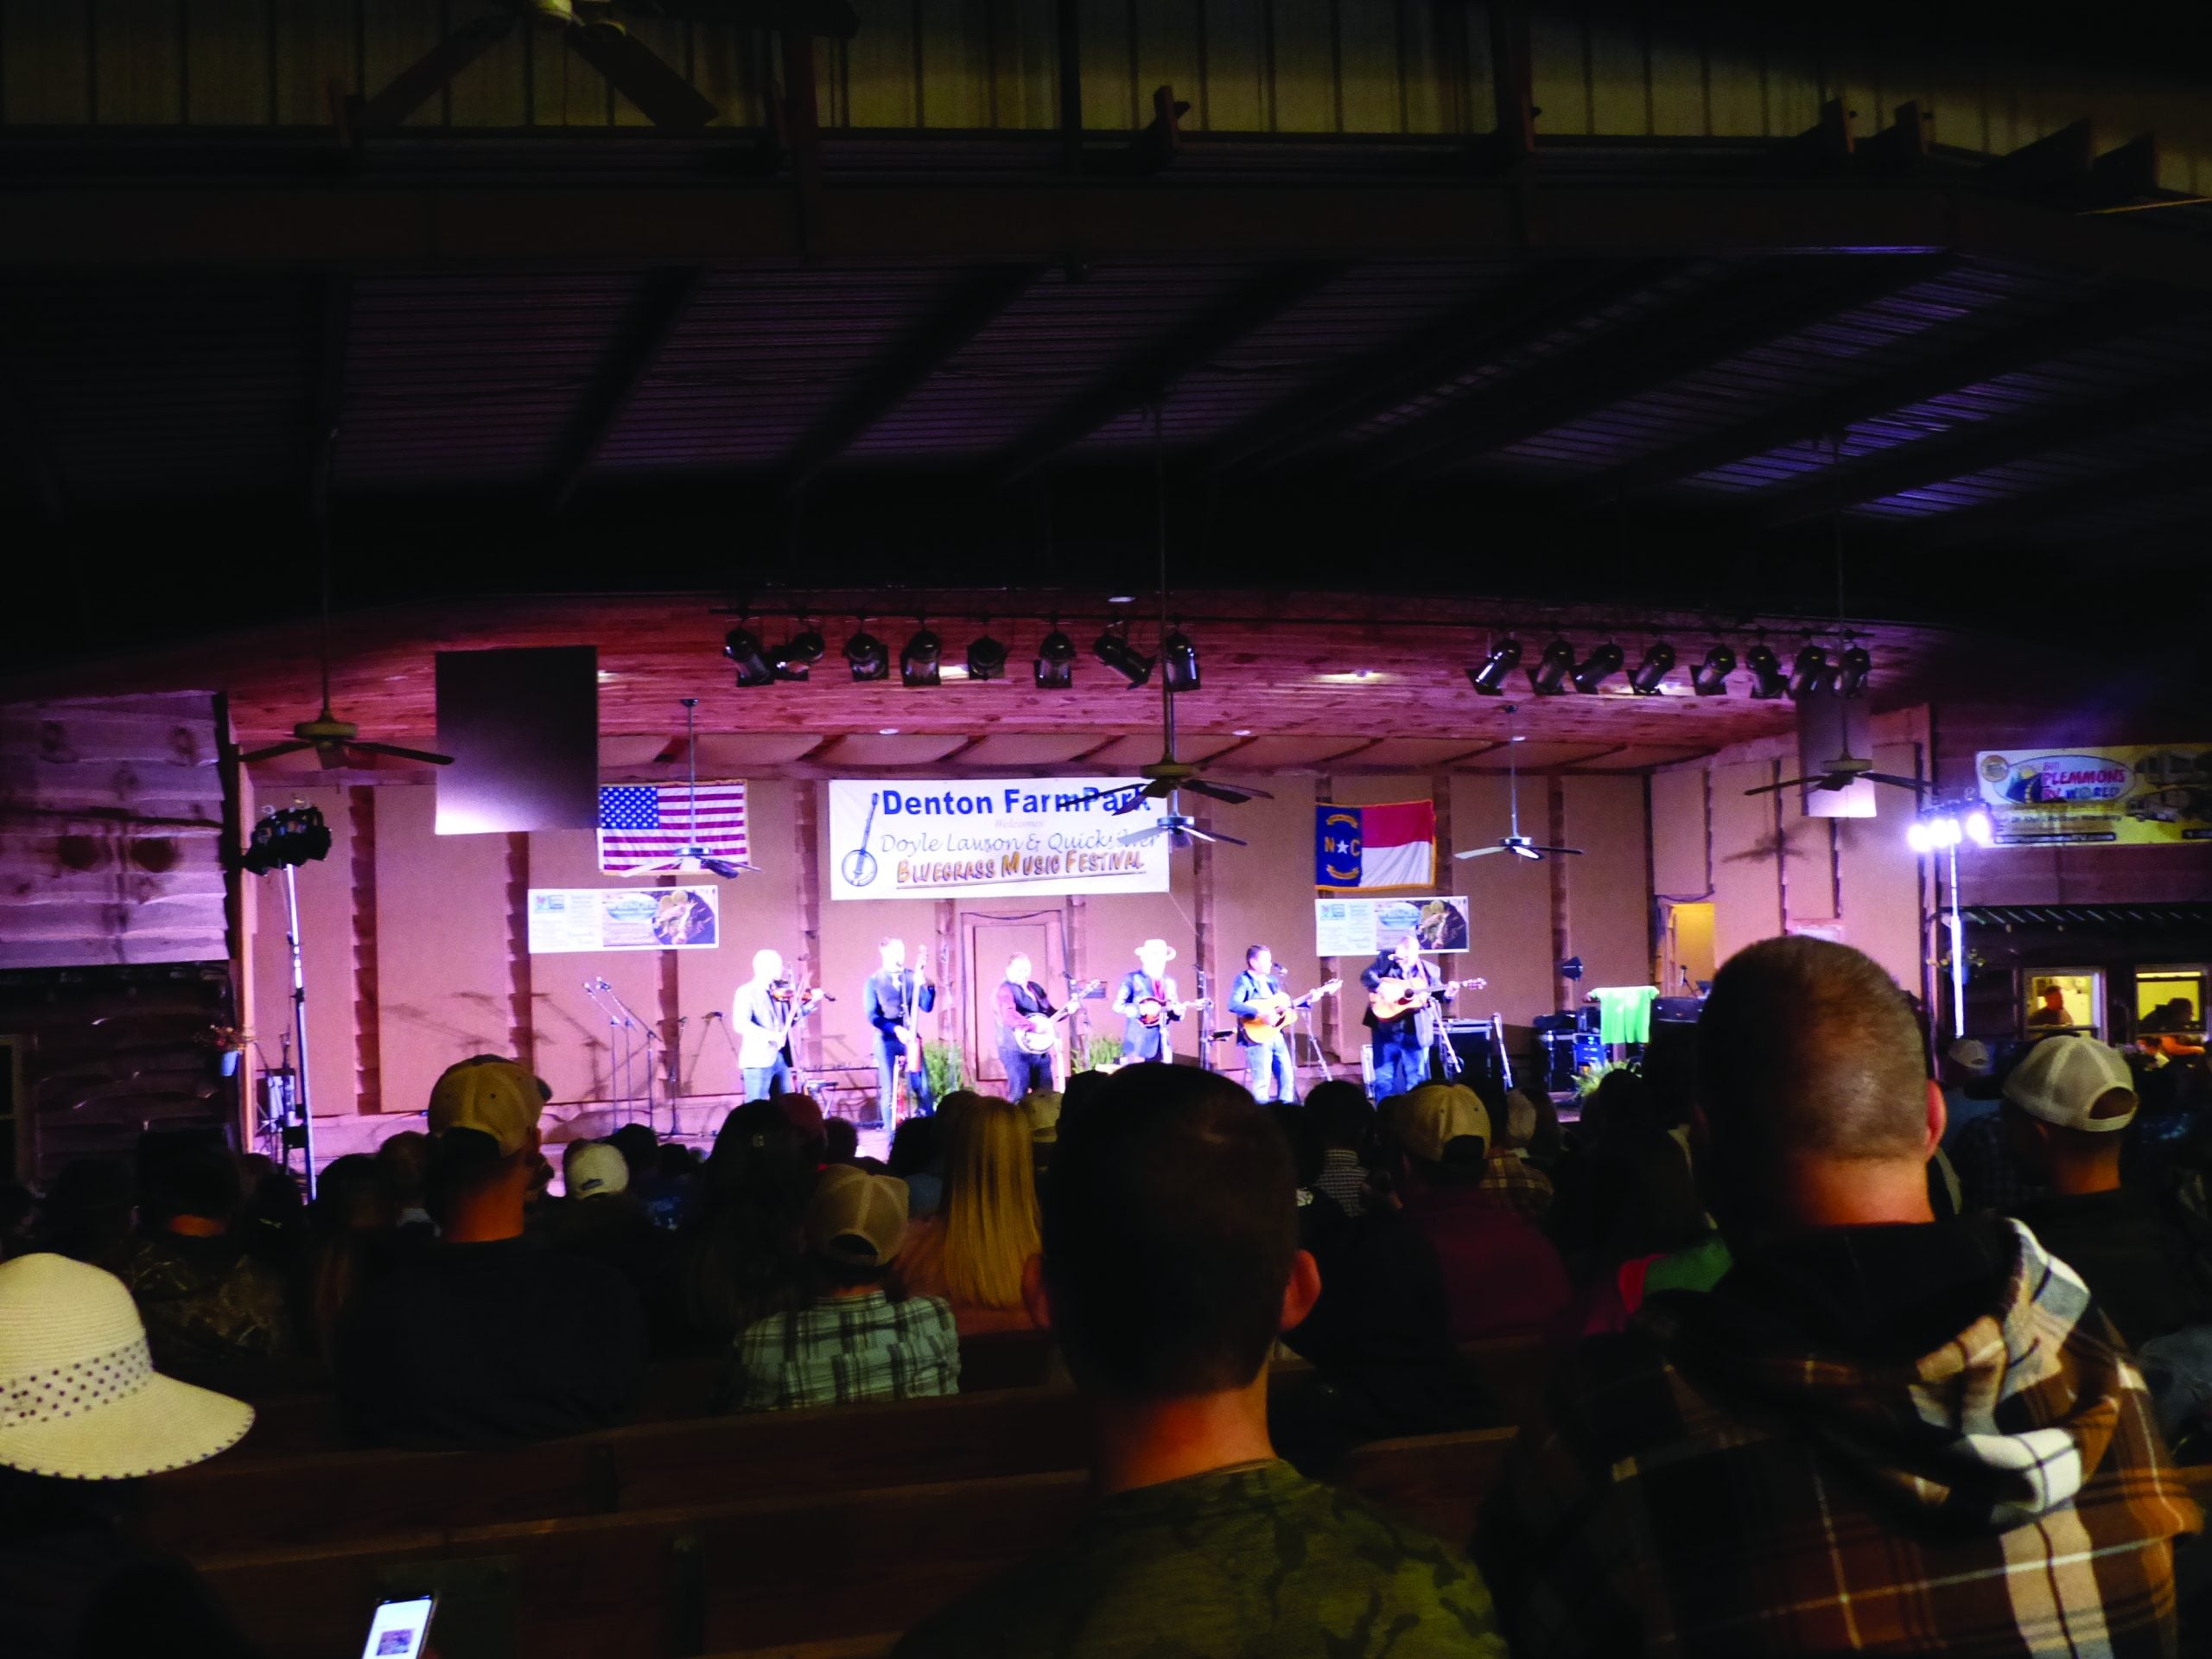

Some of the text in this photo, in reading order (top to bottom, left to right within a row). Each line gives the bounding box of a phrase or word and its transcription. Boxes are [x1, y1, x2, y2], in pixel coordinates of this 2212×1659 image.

[883, 787, 1151, 815] Denton FarmPark
[880, 832, 943, 857] Doyle
[947, 833, 1024, 853] Lawson
[1027, 833, 1041, 852] &
[1325, 836, 1360, 856] N C
[897, 849, 1145, 883] BLUEGRASS MUSIC FESTIVAL
